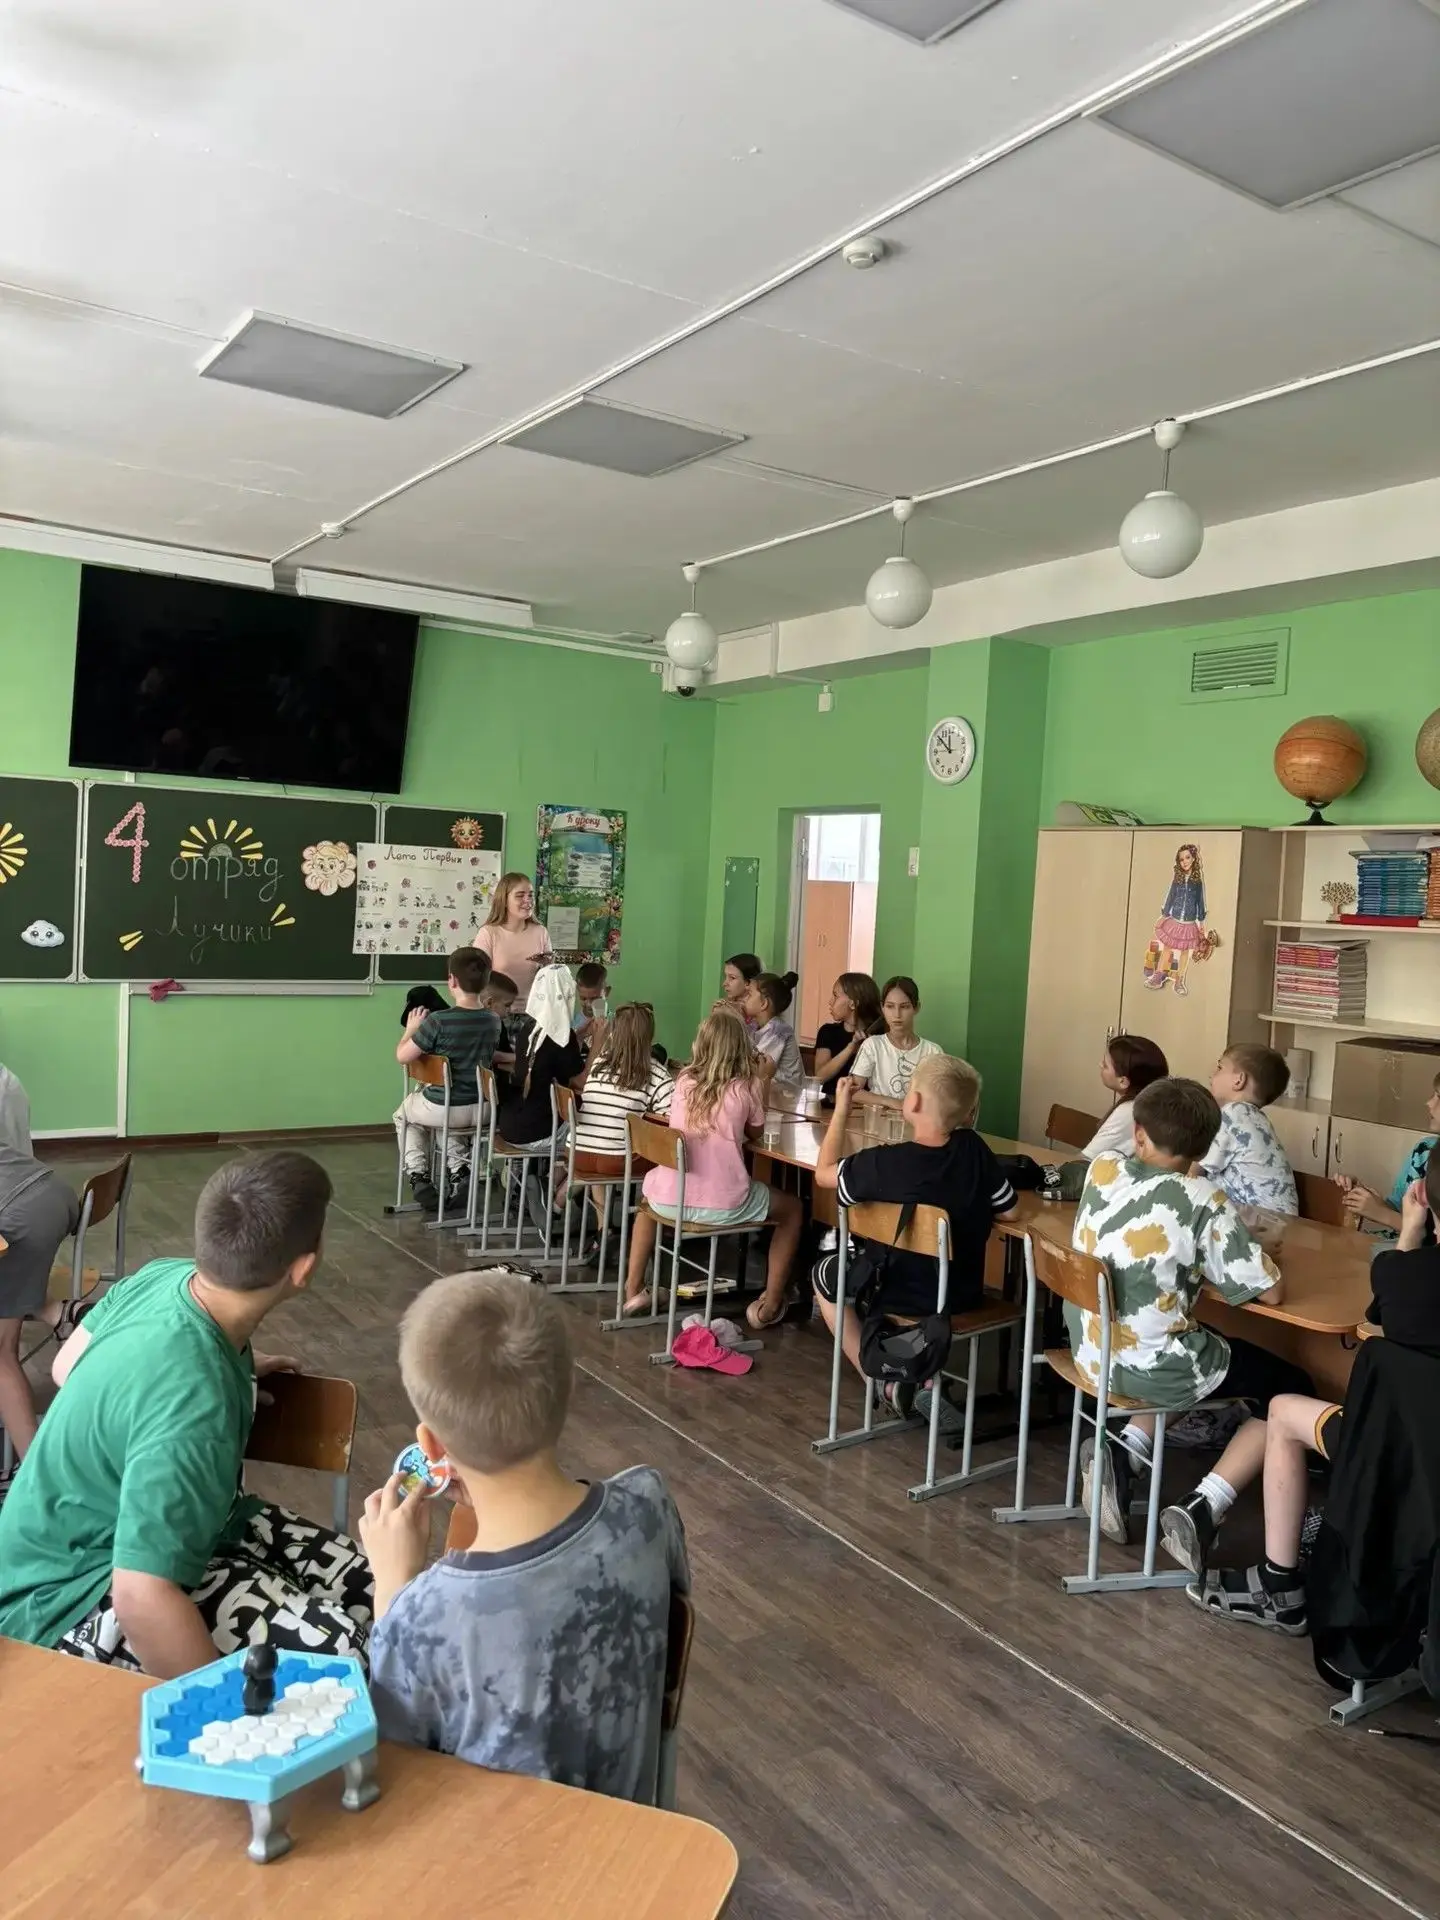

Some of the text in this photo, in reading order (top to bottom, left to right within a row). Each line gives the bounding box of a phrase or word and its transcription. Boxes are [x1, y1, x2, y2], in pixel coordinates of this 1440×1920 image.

[104, 801, 149, 883] 4
[170, 855, 285, 902] отряд
[154, 895, 272, 964] Лучики
